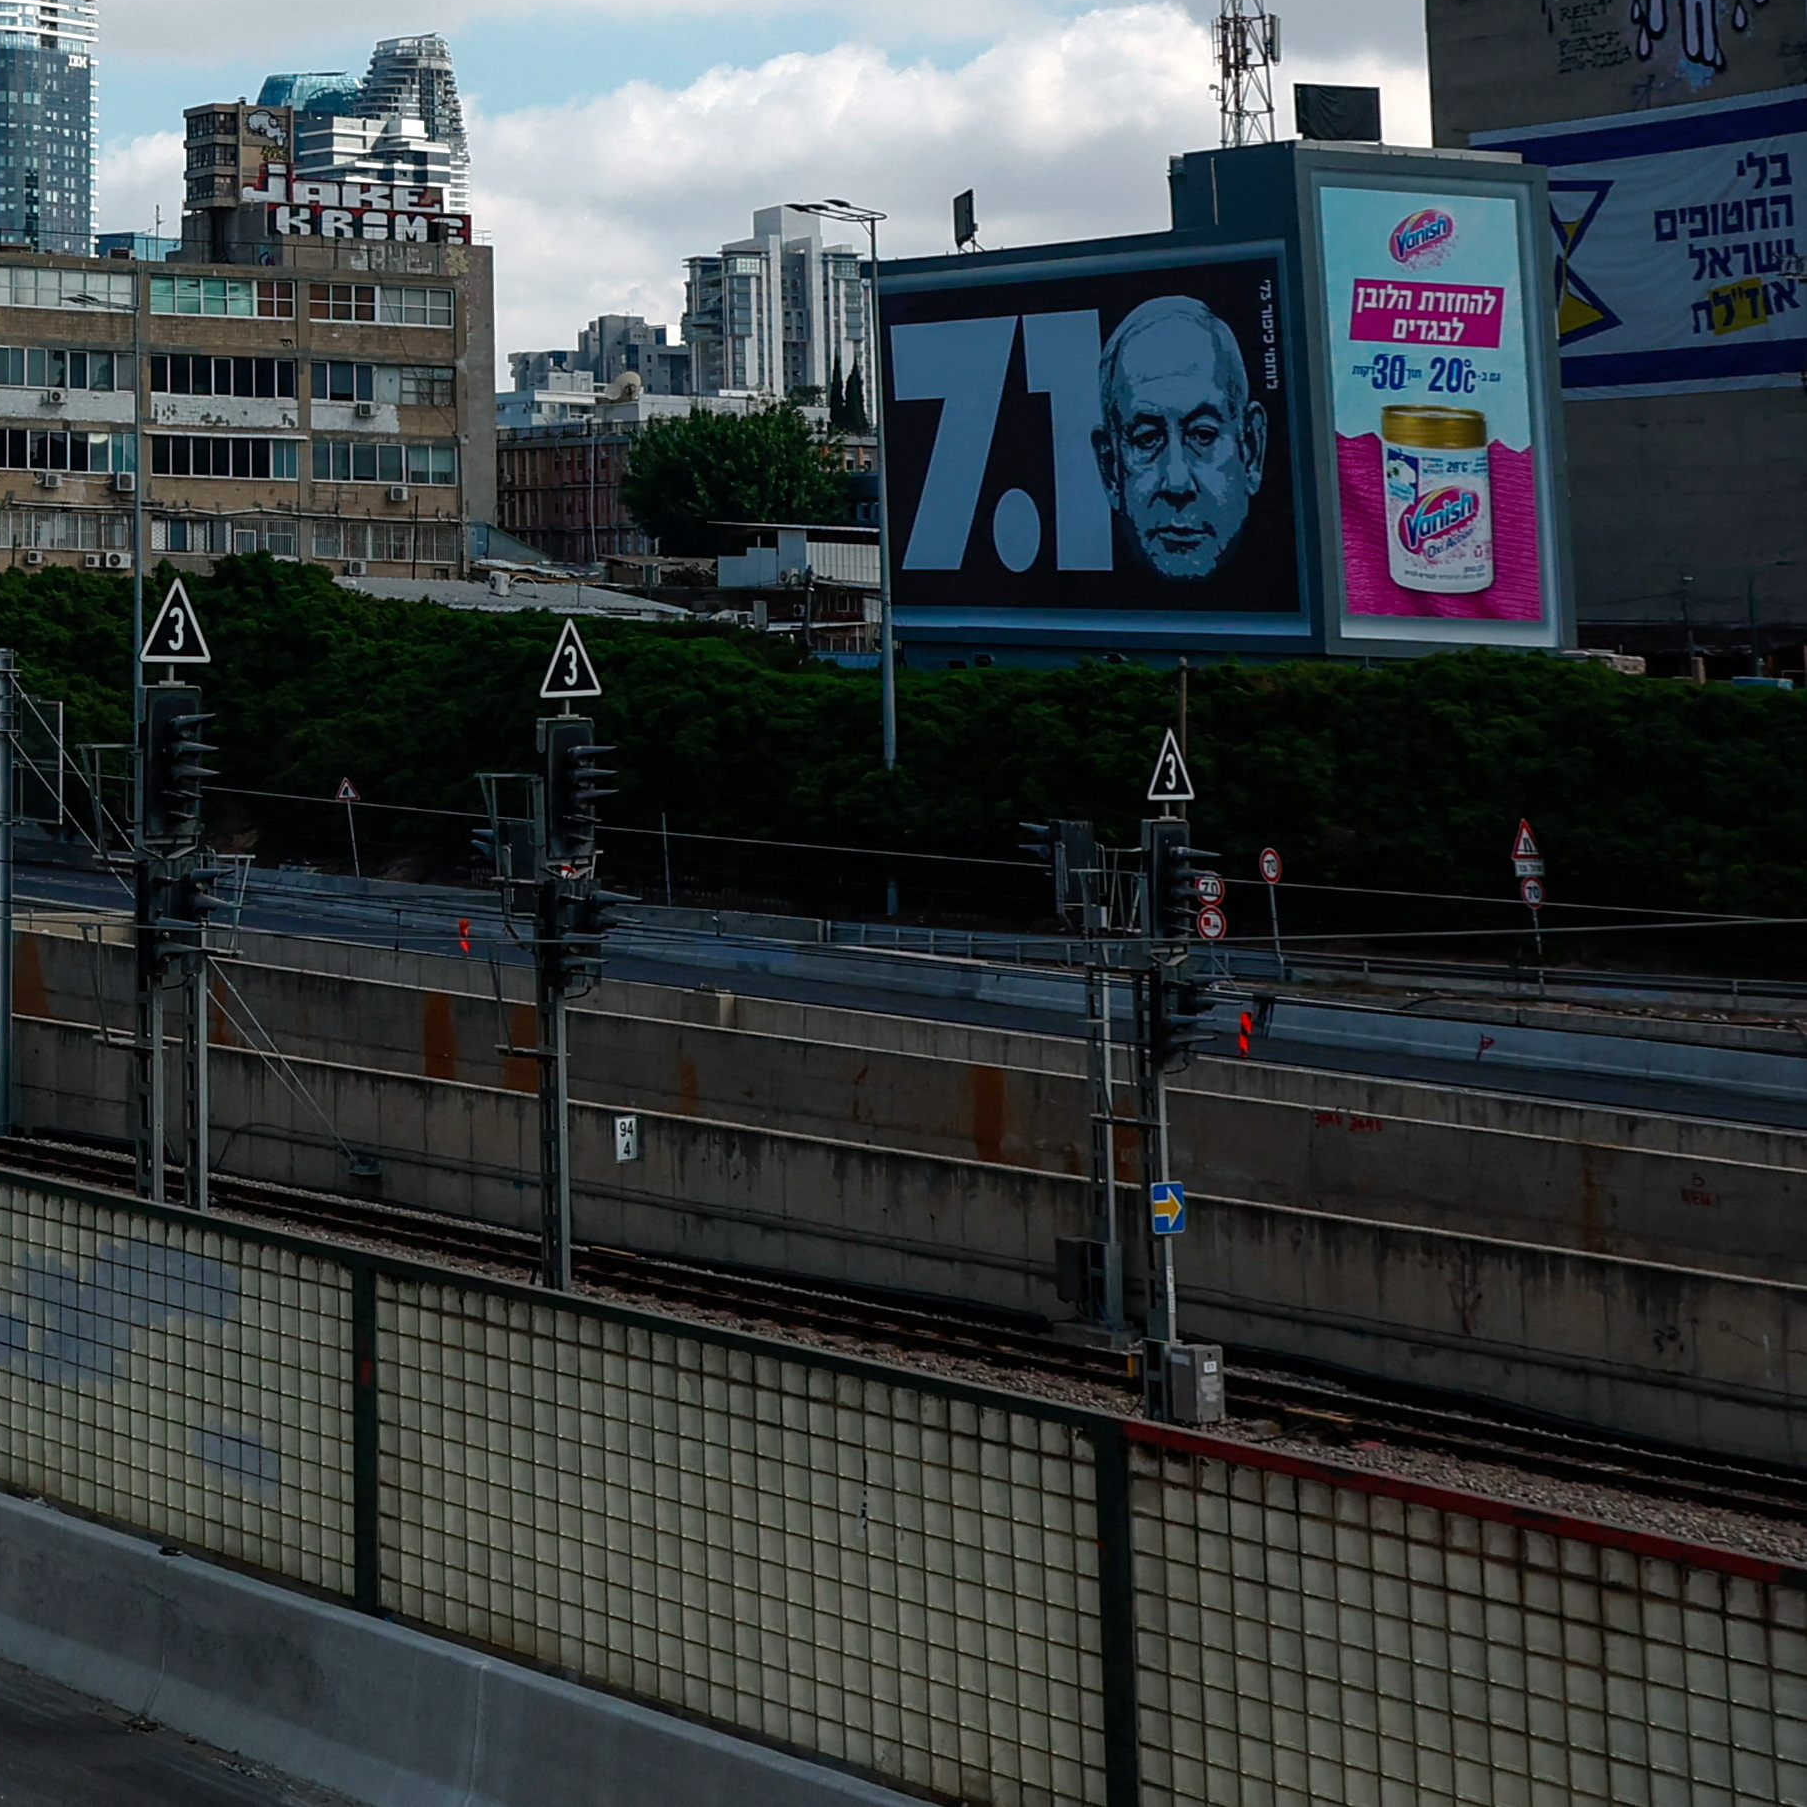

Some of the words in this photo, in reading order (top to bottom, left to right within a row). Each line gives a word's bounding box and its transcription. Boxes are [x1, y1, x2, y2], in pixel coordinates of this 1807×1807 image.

[69, 55, 87, 68] IBM
[1736, 152, 1792, 189] בלי
[1654, 194, 1794, 241] החטופים
[1395, 217, 1447, 258] Vanish
[1688, 238, 1795, 280] ישראל
[1356, 284, 1412, 313] הלובן
[1418, 290, 1496, 314] להחזרת
[1262, 304, 1275, 343] כיפור
[1392, 317, 1465, 342] לבגדים
[1372, 353, 1407, 390] 30
[1404, 492, 1473, 548] Vanish
[168, 606, 184, 651] 3
[564, 645, 578, 686] 3
[1165, 753, 1176, 790] 3
[620, 1120, 634, 1137] 94
[624, 1141, 631, 1156] 4
